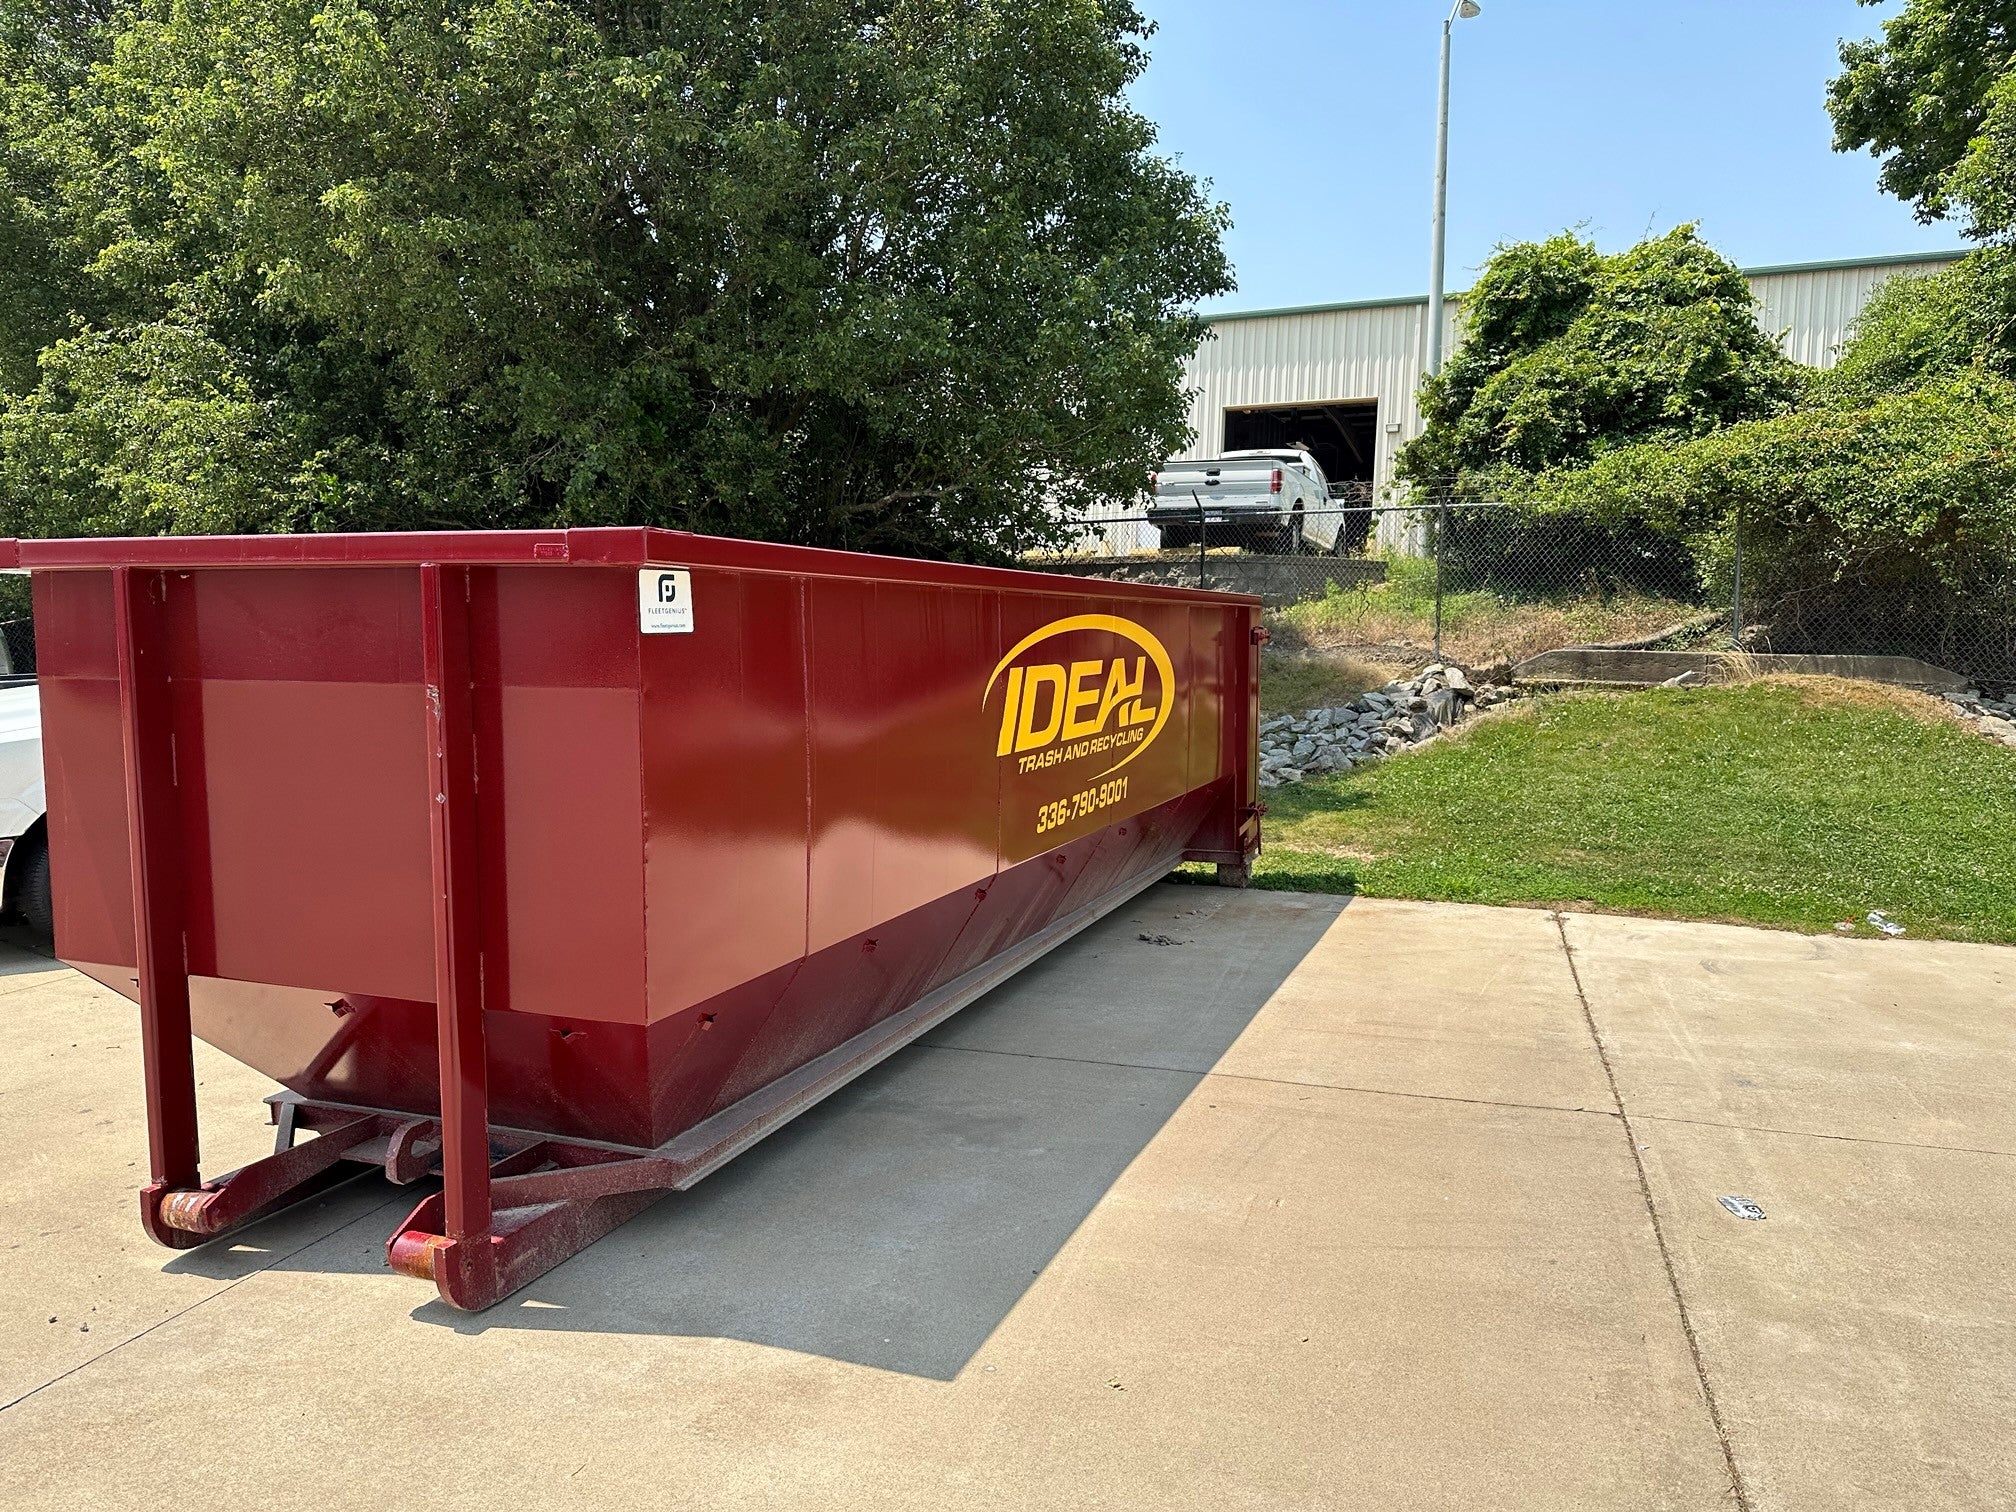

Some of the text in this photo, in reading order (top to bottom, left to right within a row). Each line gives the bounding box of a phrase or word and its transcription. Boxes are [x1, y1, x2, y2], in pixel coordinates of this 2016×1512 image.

[996, 656, 1157, 757] IDEAL
[1018, 727, 1144, 775] TRASH AND RECYCLING
[1036, 776, 1129, 834] 336-790-9001
